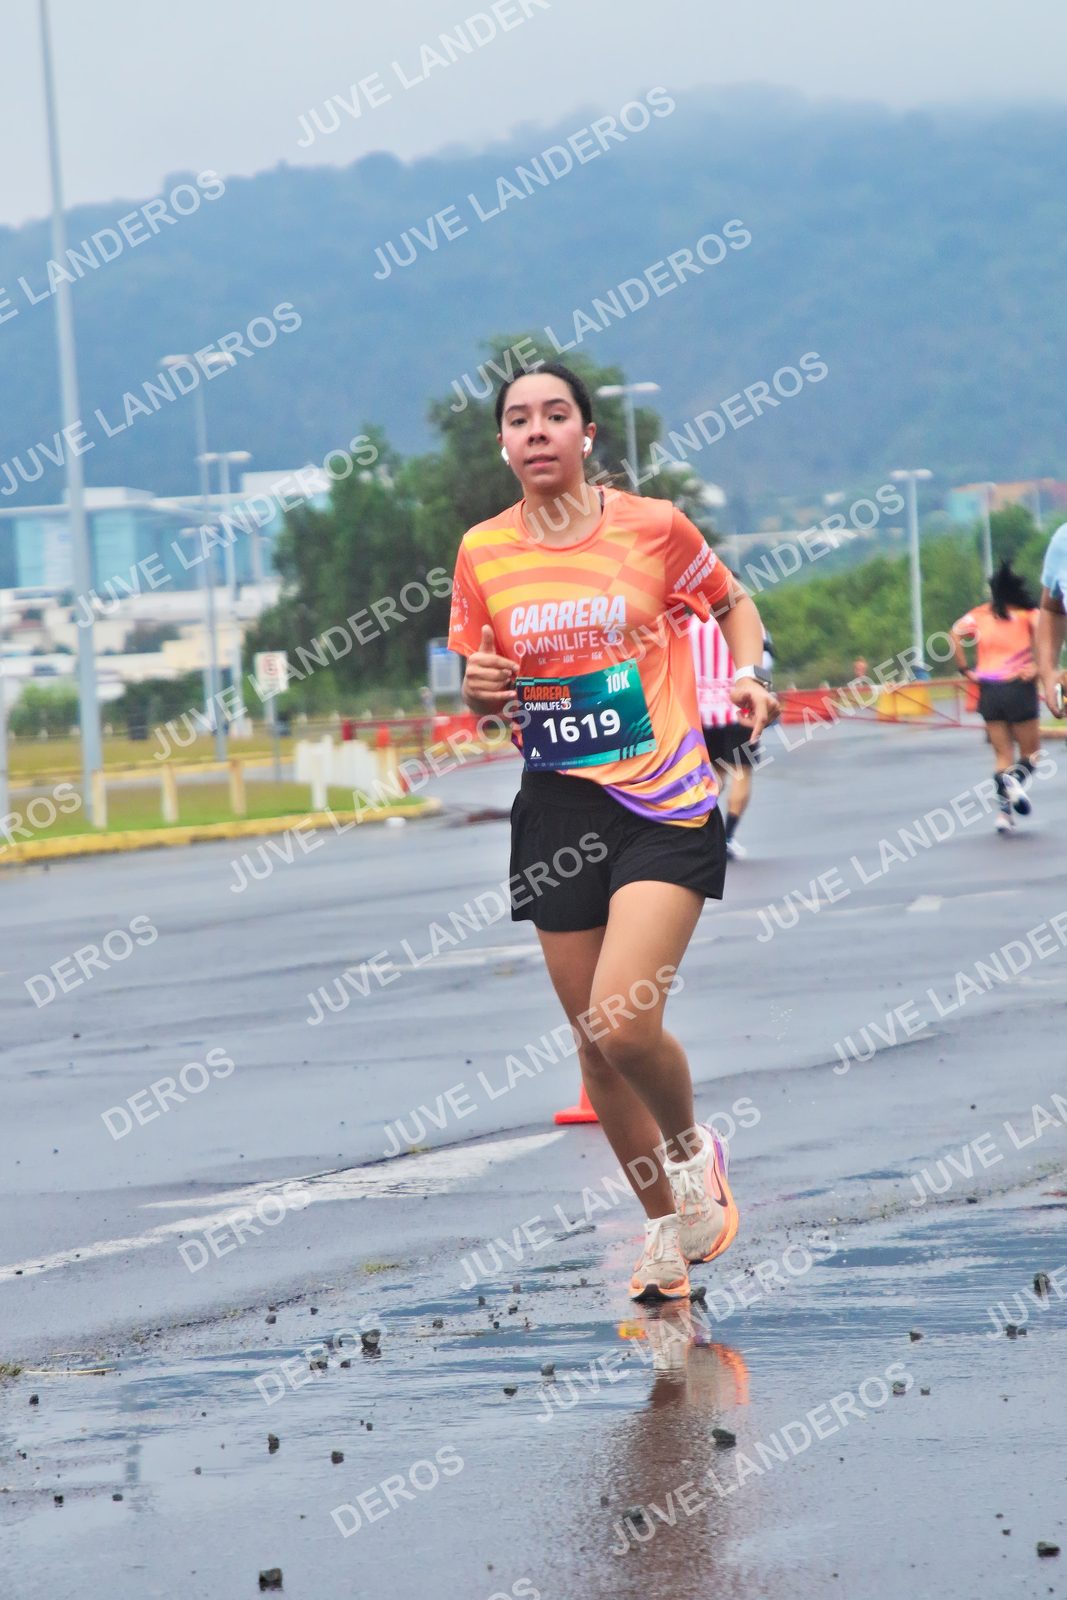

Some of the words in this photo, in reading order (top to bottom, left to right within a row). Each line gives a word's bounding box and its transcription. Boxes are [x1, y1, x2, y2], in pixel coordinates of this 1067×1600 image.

[510, 595, 626, 636] CARRERA
[513, 630, 600, 658] OMNILIFE
[523, 686, 570, 700] CARRERA
[606, 670, 630, 694] 10K
[524, 701, 561, 711] OMNILIFE
[542, 708, 621, 744] 1619
